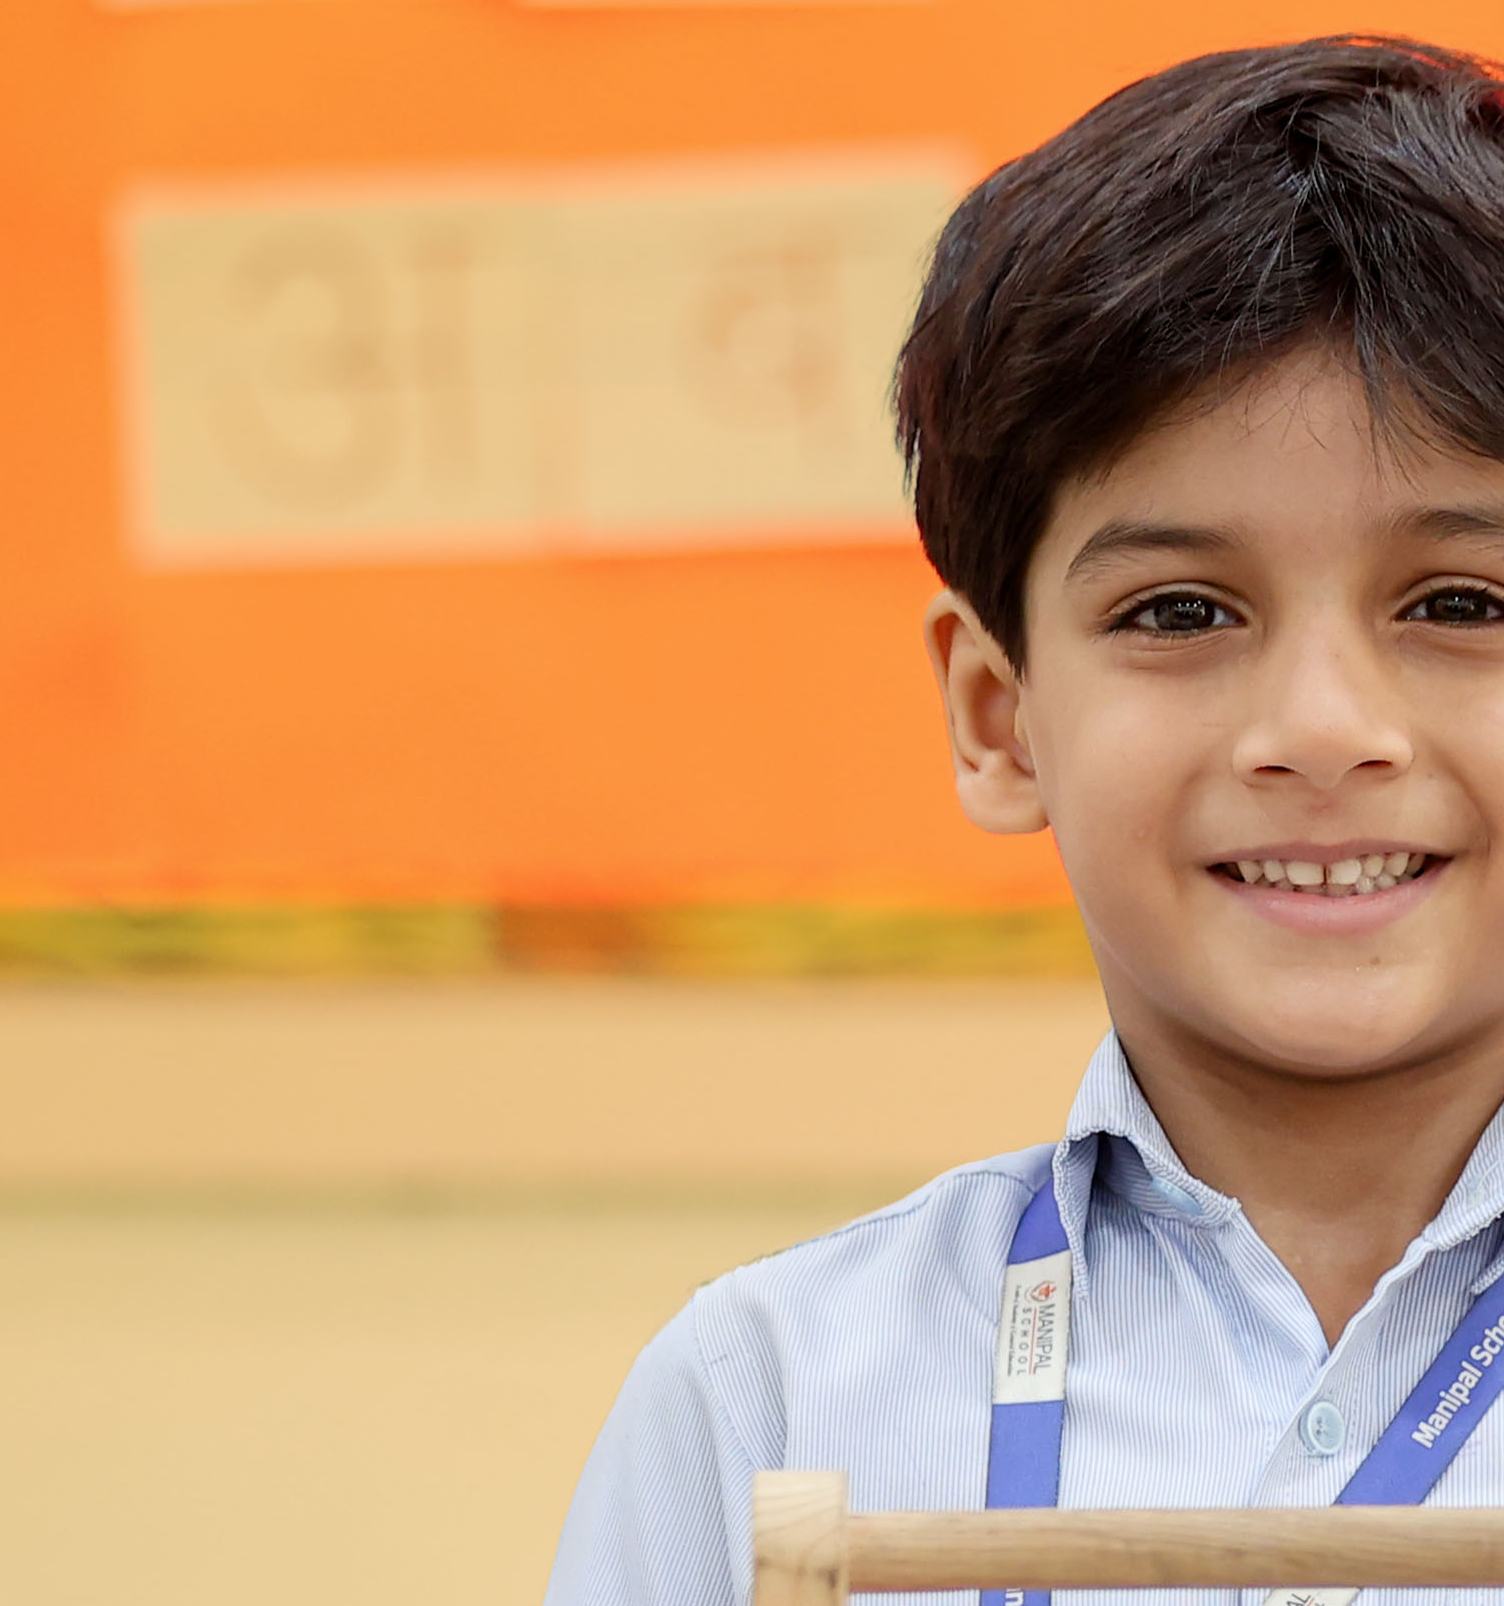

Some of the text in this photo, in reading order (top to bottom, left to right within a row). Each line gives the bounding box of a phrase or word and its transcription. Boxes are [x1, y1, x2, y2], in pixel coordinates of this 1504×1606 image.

[1017, 1307, 1032, 1375] SCHOOL
[1033, 1303, 1055, 1374] MANIPAL
[1411, 1361, 1482, 1448] Manipal
